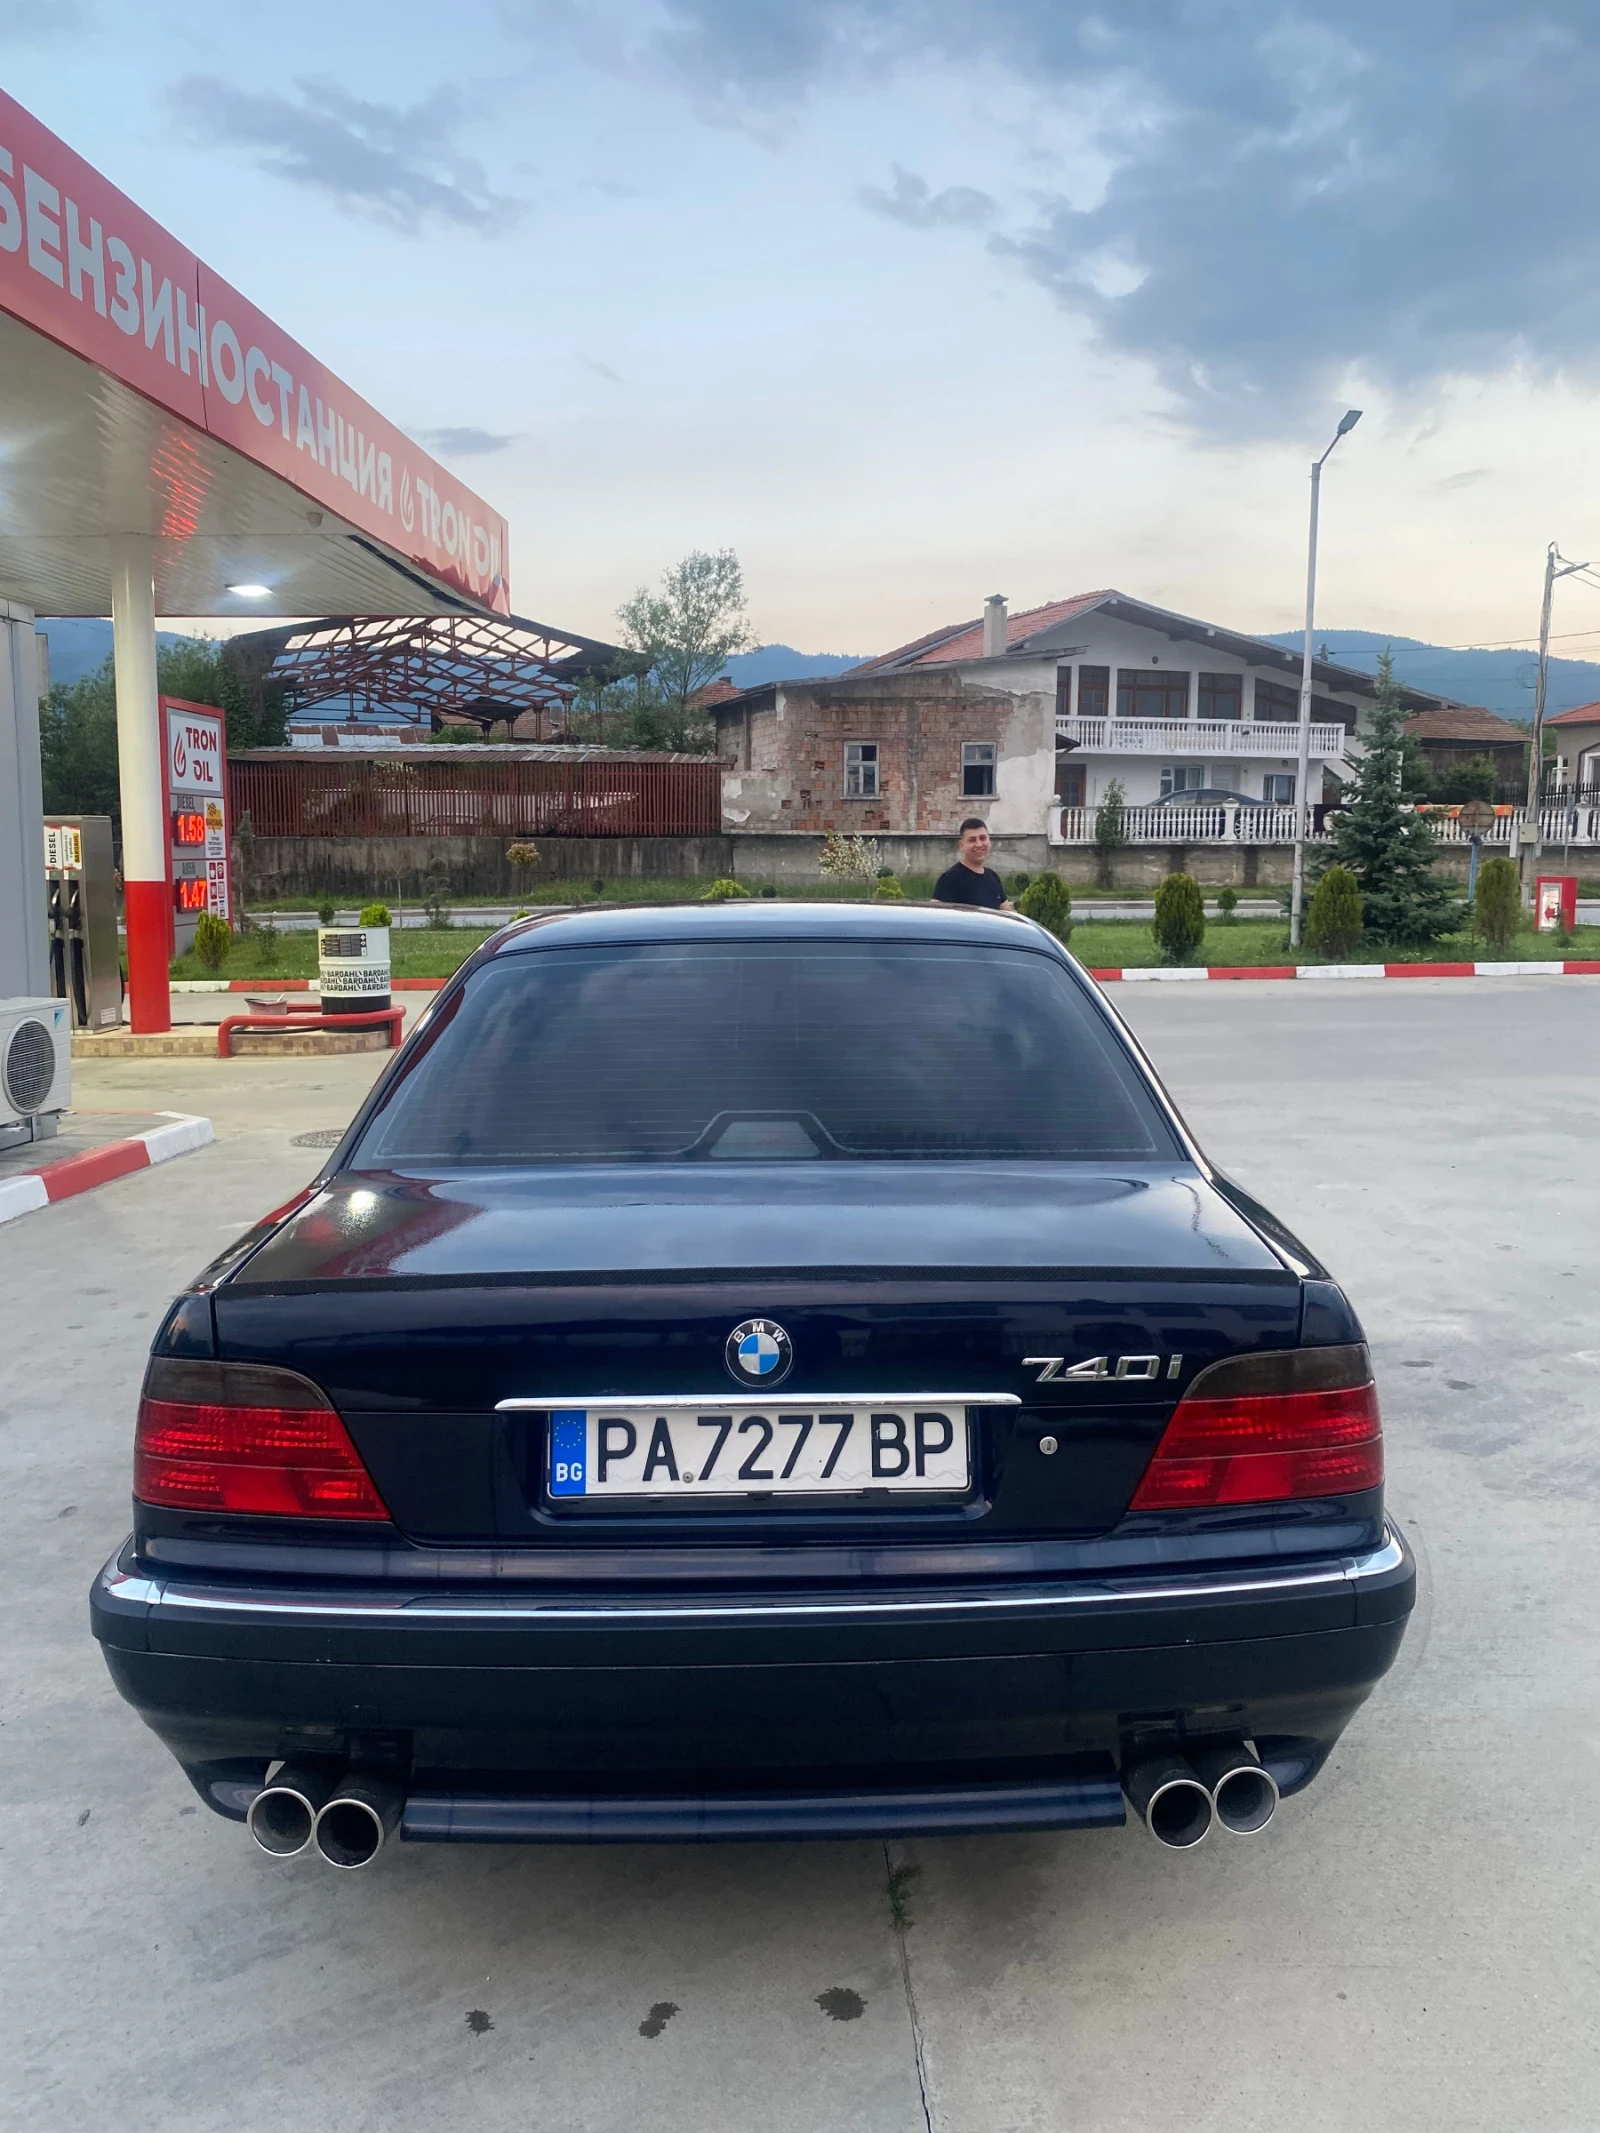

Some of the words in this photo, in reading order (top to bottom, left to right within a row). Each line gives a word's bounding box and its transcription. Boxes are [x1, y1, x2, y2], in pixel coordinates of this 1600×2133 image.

[417, 477, 471, 567] TRON
[185, 727, 217, 752] TRON
[193, 760, 213, 782] OIL
[177, 795, 195, 810] DIESEL
[178, 814, 204, 842] 1.58
[48, 832, 57, 863] DIESEL
[180, 880, 207, 907] 1.47
[327, 970, 360, 978] BARDAHL
[342, 977, 377, 985] BARDAHL
[733, 1322, 786, 1343] BMW
[1022, 1354, 1183, 1382] 740i
[598, 1417, 681, 1483] PA
[698, 1414, 855, 1481] 7277
[870, 1413, 953, 1479] BP
[556, 1463, 583, 1482] BG
